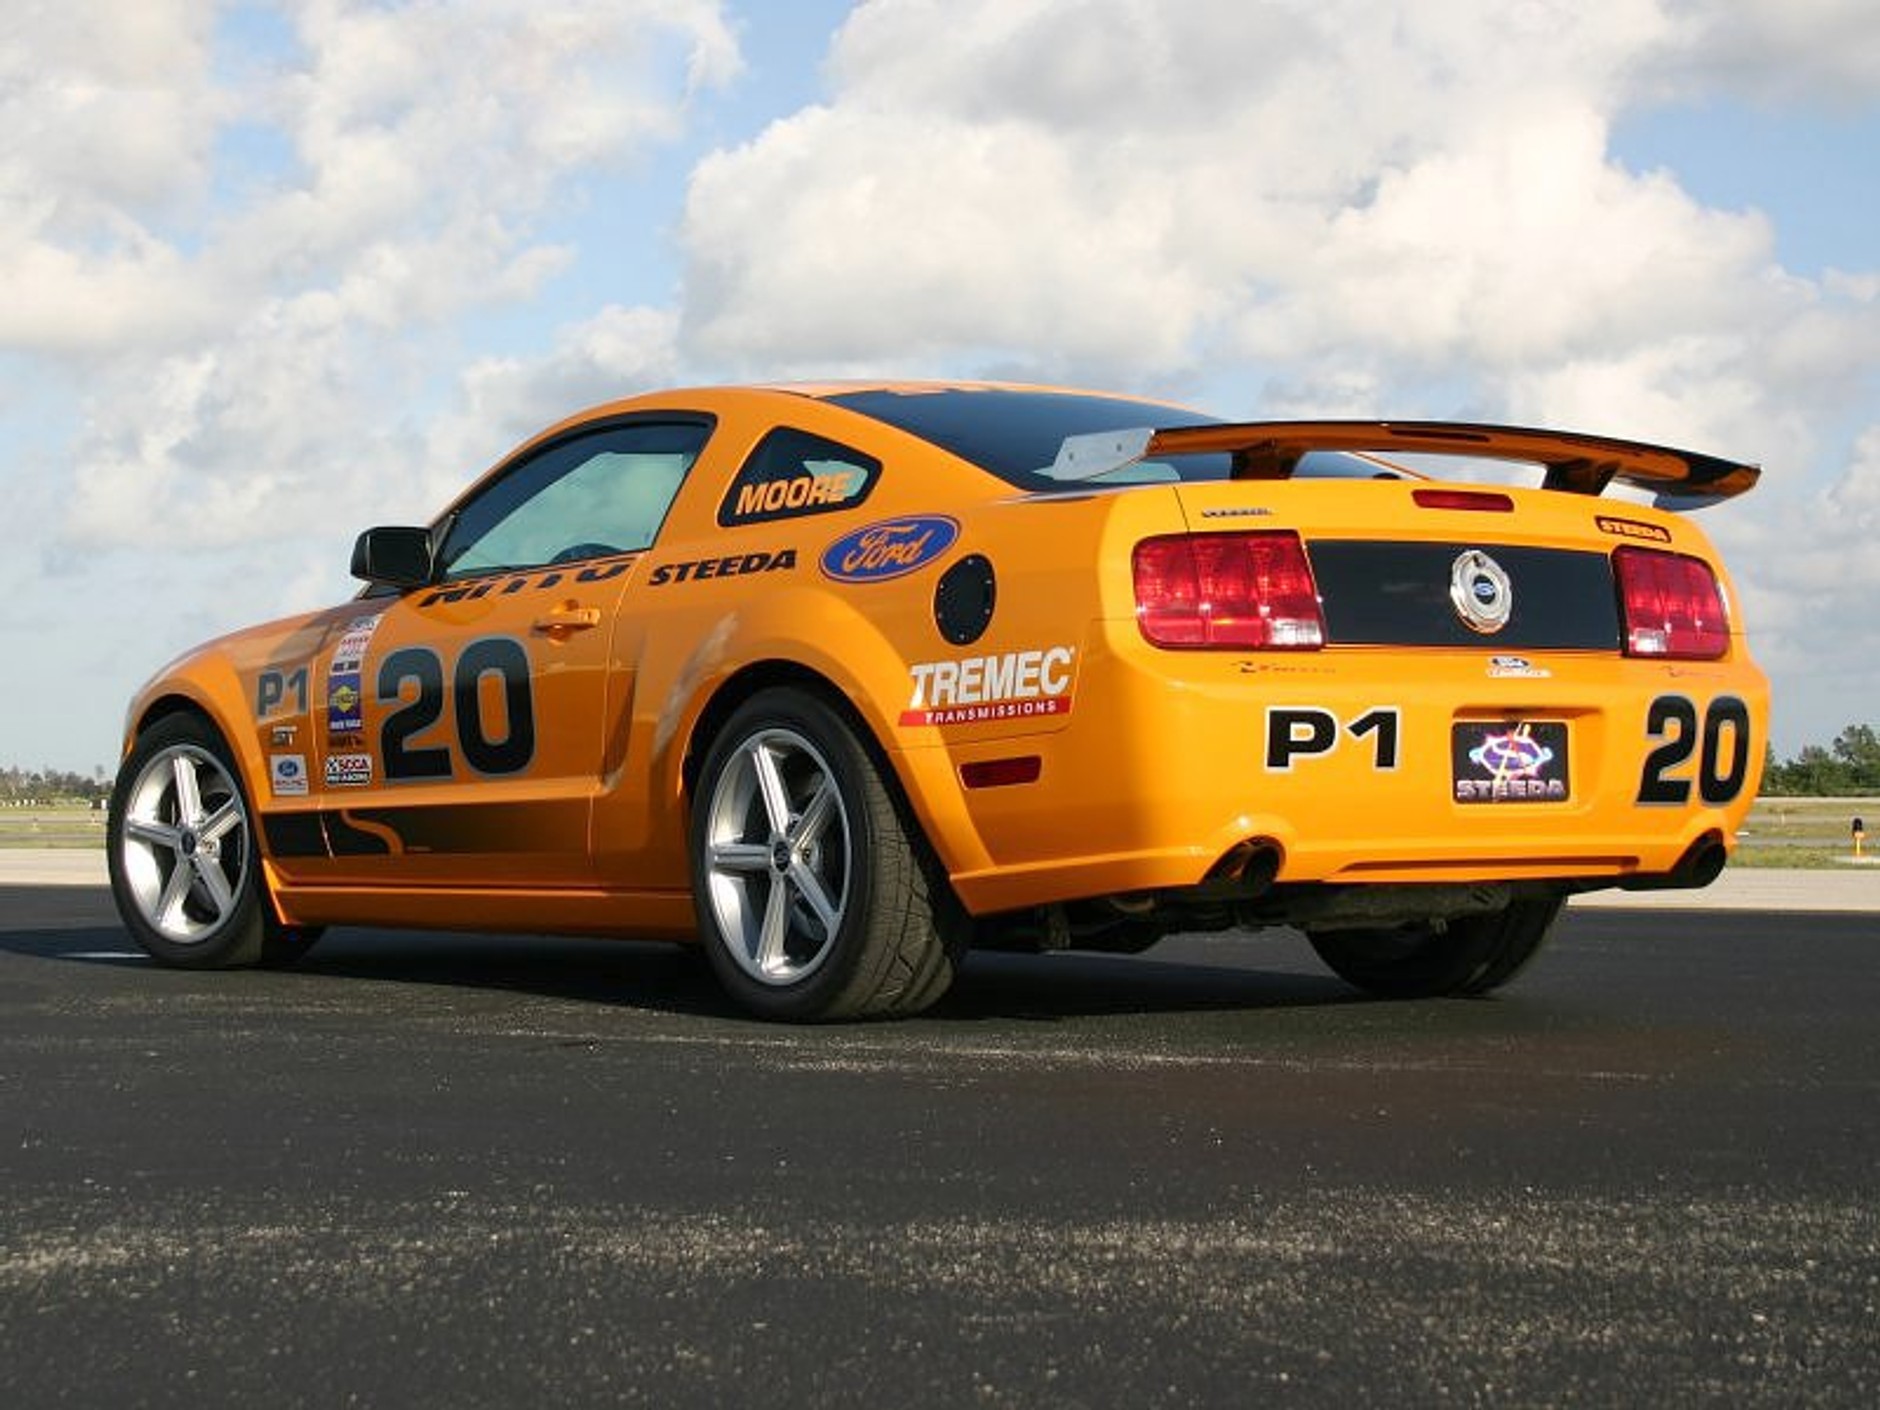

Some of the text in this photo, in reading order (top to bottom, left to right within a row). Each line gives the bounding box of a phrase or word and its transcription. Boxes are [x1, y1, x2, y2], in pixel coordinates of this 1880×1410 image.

[735, 473, 856, 515] MOORE
[649, 550, 797, 585] STEEDA
[843, 523, 933, 572] Ford
[256, 666, 309, 718] P1
[910, 647, 1071, 709] TREMEC
[377, 636, 535, 783] 20
[924, 700, 1057, 724] TRANSMISSIONS
[1266, 708, 1400, 772] P1
[1638, 694, 1750, 806] 20
[1457, 780, 1565, 799] STEEDA
